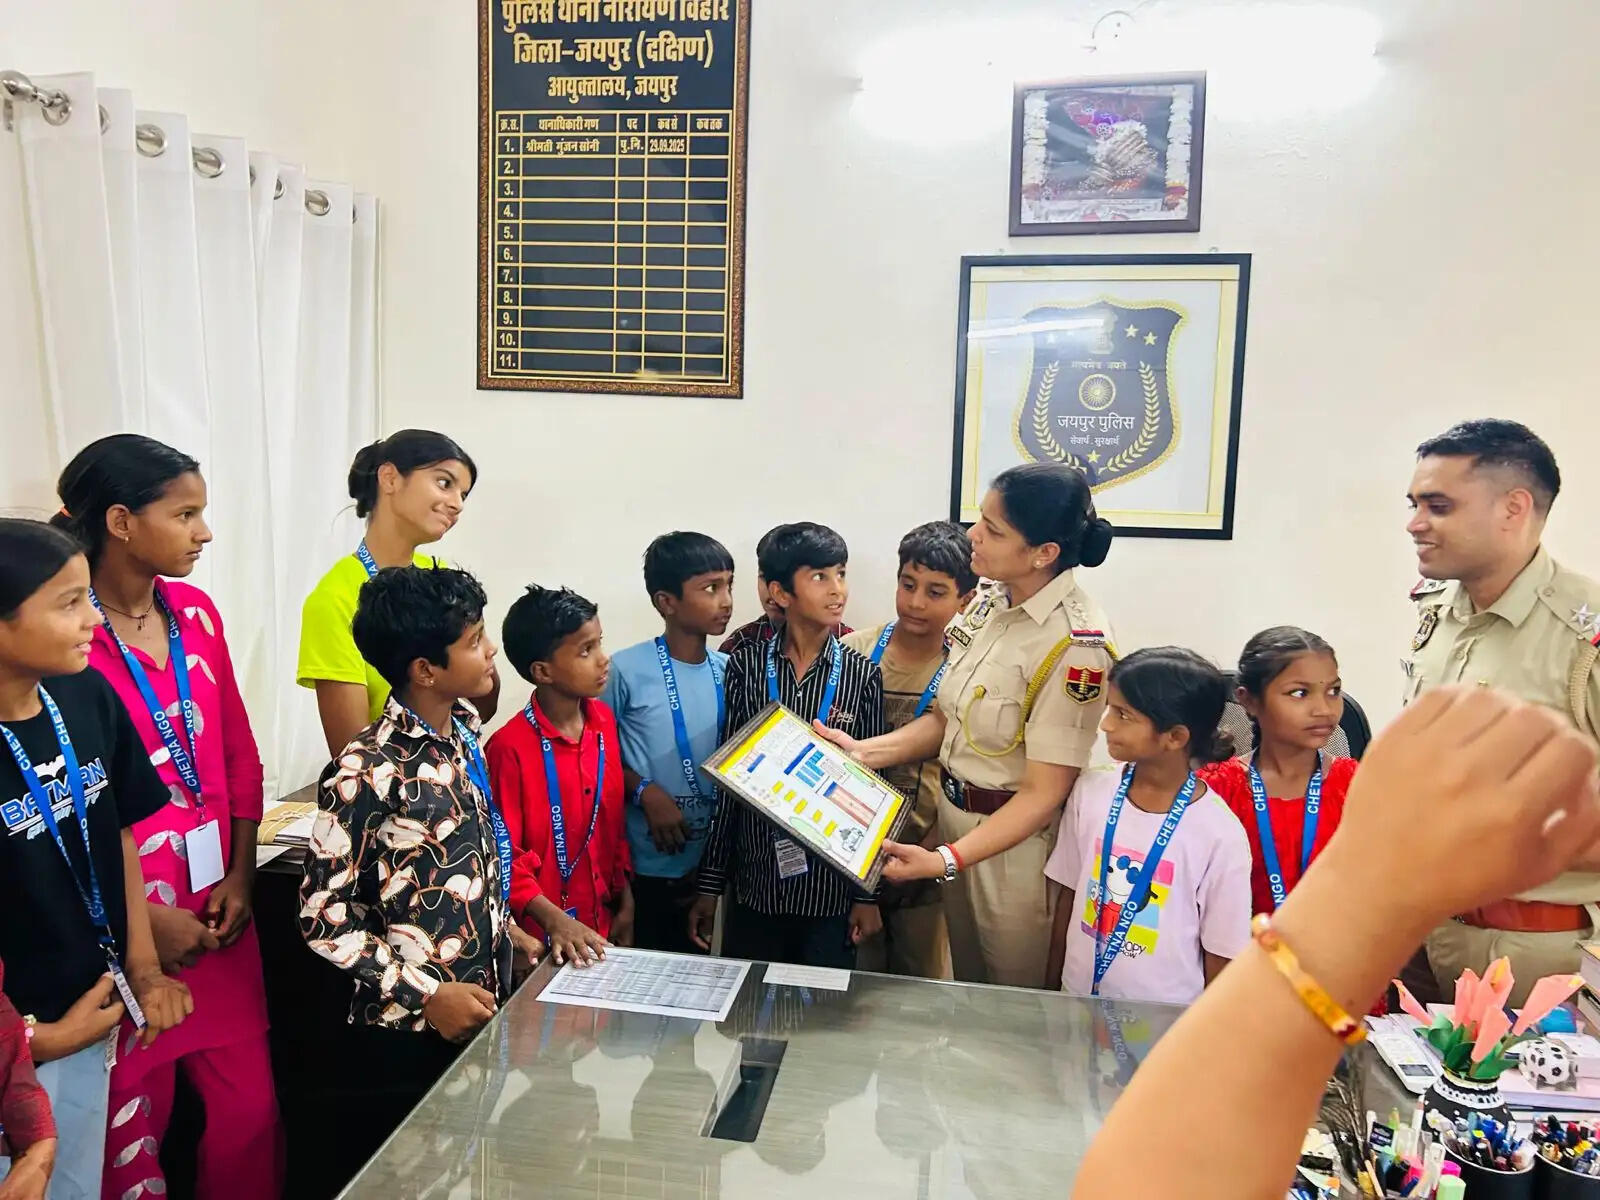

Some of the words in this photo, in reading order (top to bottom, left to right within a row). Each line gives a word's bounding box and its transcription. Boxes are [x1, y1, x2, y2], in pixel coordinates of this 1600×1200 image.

[636, 29, 714, 68] (दक्षिण)
[634, 76, 678, 103] जयपुर
[627, 118, 638, 130] पद
[504, 139, 515, 152] 1.
[526, 139, 553, 152] श्रीमती
[650, 139, 685, 152] 29.09.2025
[503, 161, 514, 174] 2.
[503, 183, 514, 196] 3.
[503, 205, 514, 217] 4.
[503, 227, 514, 239] 5.
[503, 248, 514, 260] 6.
[503, 270, 514, 282] 7.
[503, 291, 514, 303] 8.
[503, 312, 514, 324] 9.
[500, 333, 516, 346] 10.
[500, 354, 516, 367] 11.
[1057, 415, 1096, 432] जयपुर
[1098, 412, 1135, 432] पुलिस
[657, 645, 669, 667] NGO
[664, 668, 680, 710] CHETNA
[183, 700, 194, 728] NGO
[153, 711, 175, 739] NGO
[168, 738, 198, 787] CHETNA
[682, 758, 695, 782] NGO
[492, 811, 508, 836] NGO
[551, 805, 563, 829] NGO
[1156, 797, 1188, 847] CHETNA
[500, 839, 512, 891] CHETNA
[555, 832, 568, 878] CHETNA
[1269, 873, 1285, 904] NGO
[1097, 930, 1126, 975] CHETNA
[1118, 901, 1138, 929] NGO
